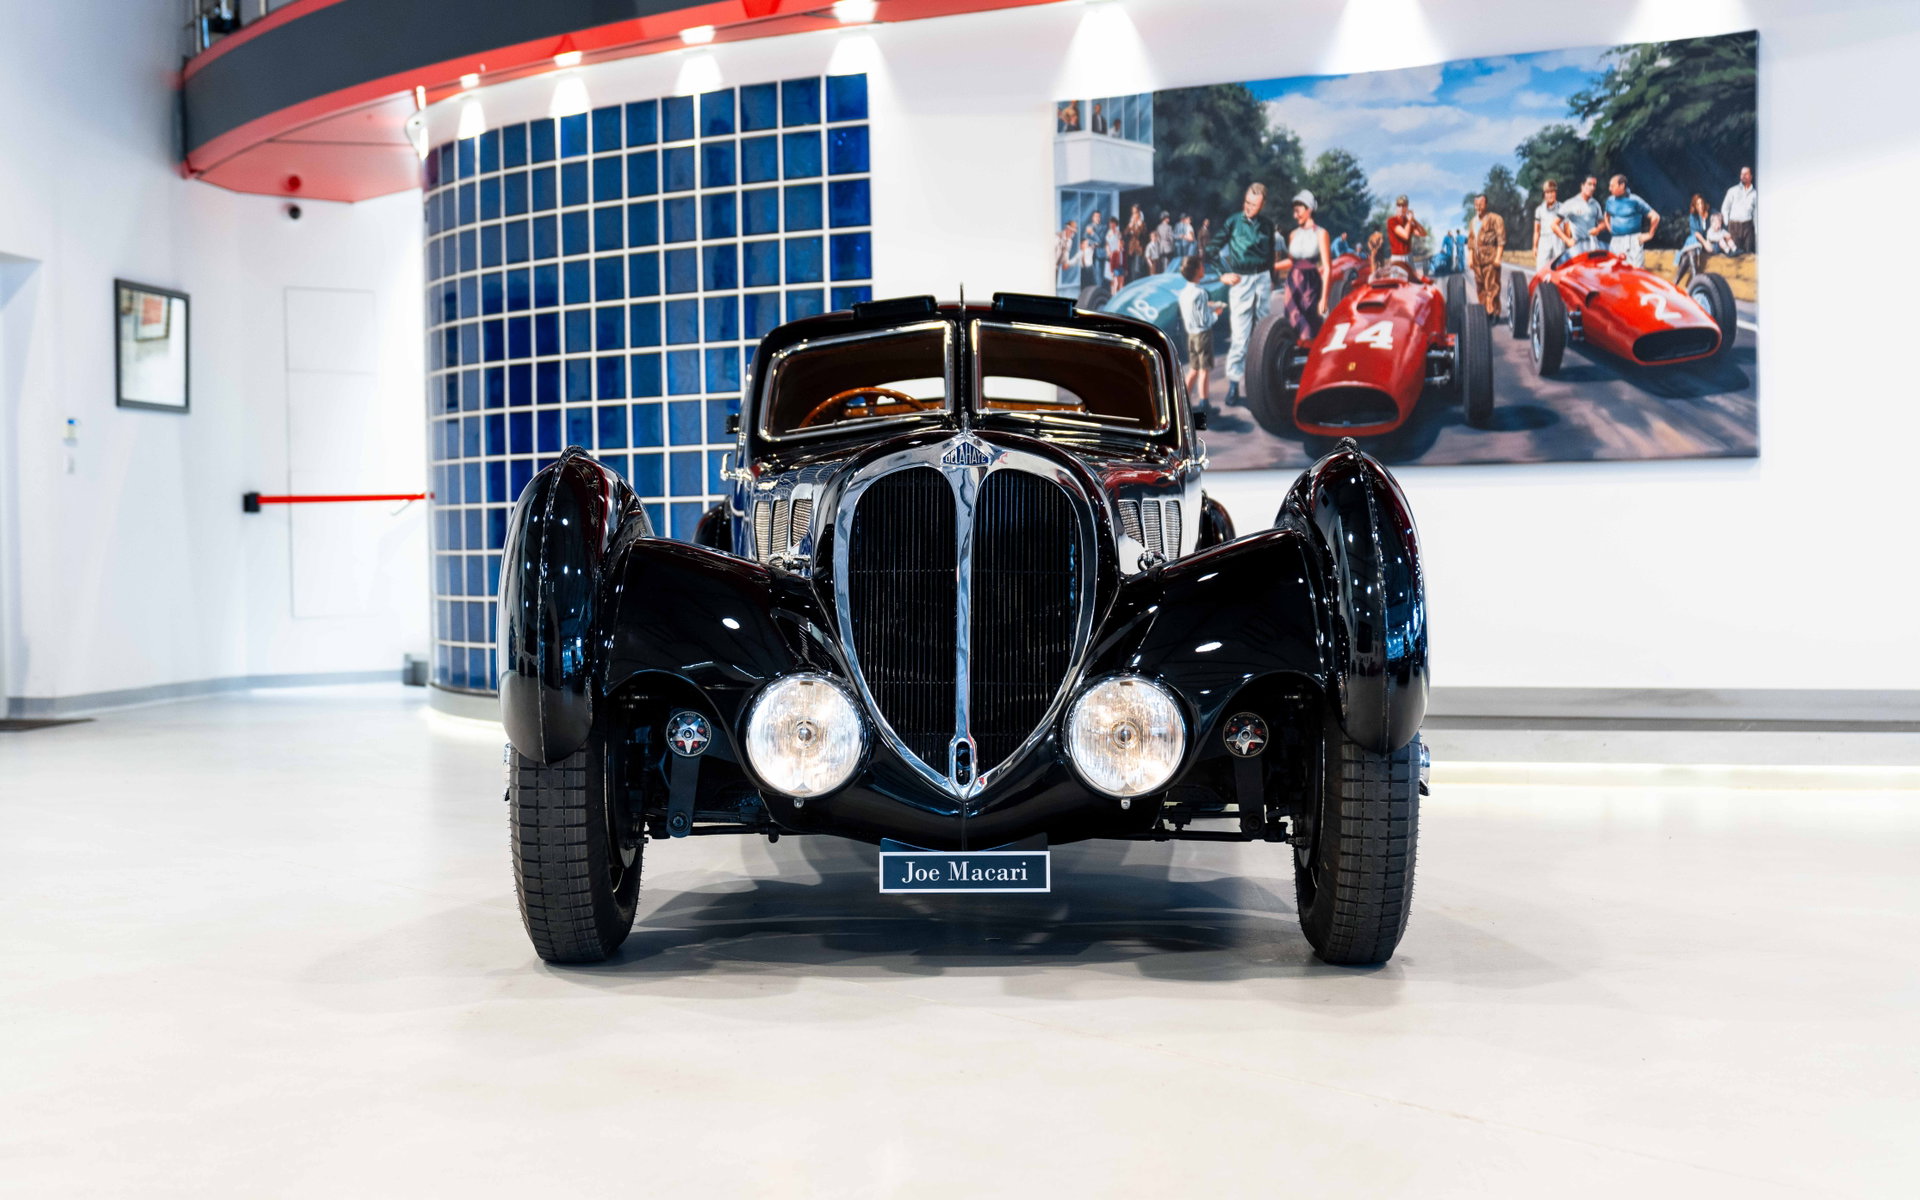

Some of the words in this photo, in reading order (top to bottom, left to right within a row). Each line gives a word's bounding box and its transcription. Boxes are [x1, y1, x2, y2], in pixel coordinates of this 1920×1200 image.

[1127, 299, 1159, 322] 18
[1640, 293, 1682, 321] 2
[1320, 320, 1394, 354] 14
[945, 442, 986, 465] DELAHAYE
[901, 861, 940, 884] Joe
[947, 860, 1028, 881] Macari
